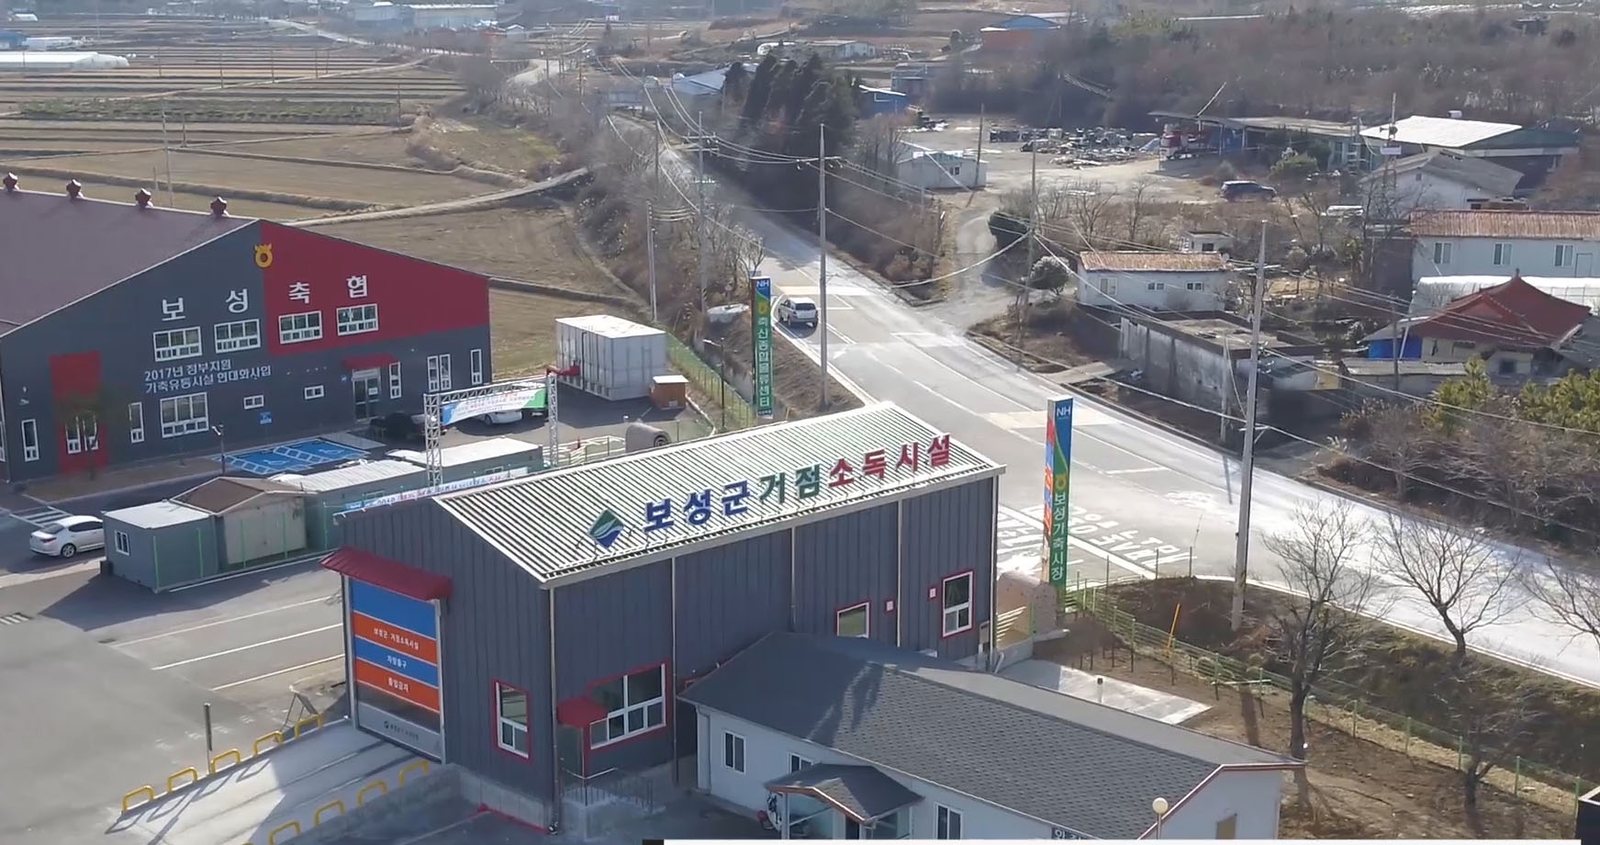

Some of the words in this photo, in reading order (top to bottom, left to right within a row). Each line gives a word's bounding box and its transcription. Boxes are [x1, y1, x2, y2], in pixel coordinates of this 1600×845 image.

[756, 280, 769, 289] NH
[144, 366, 183, 382] 2017년
[186, 359, 232, 376] 정부지원
[1056, 406, 1071, 416] NH
[1051, 494, 1066, 581] 보성가축시장
